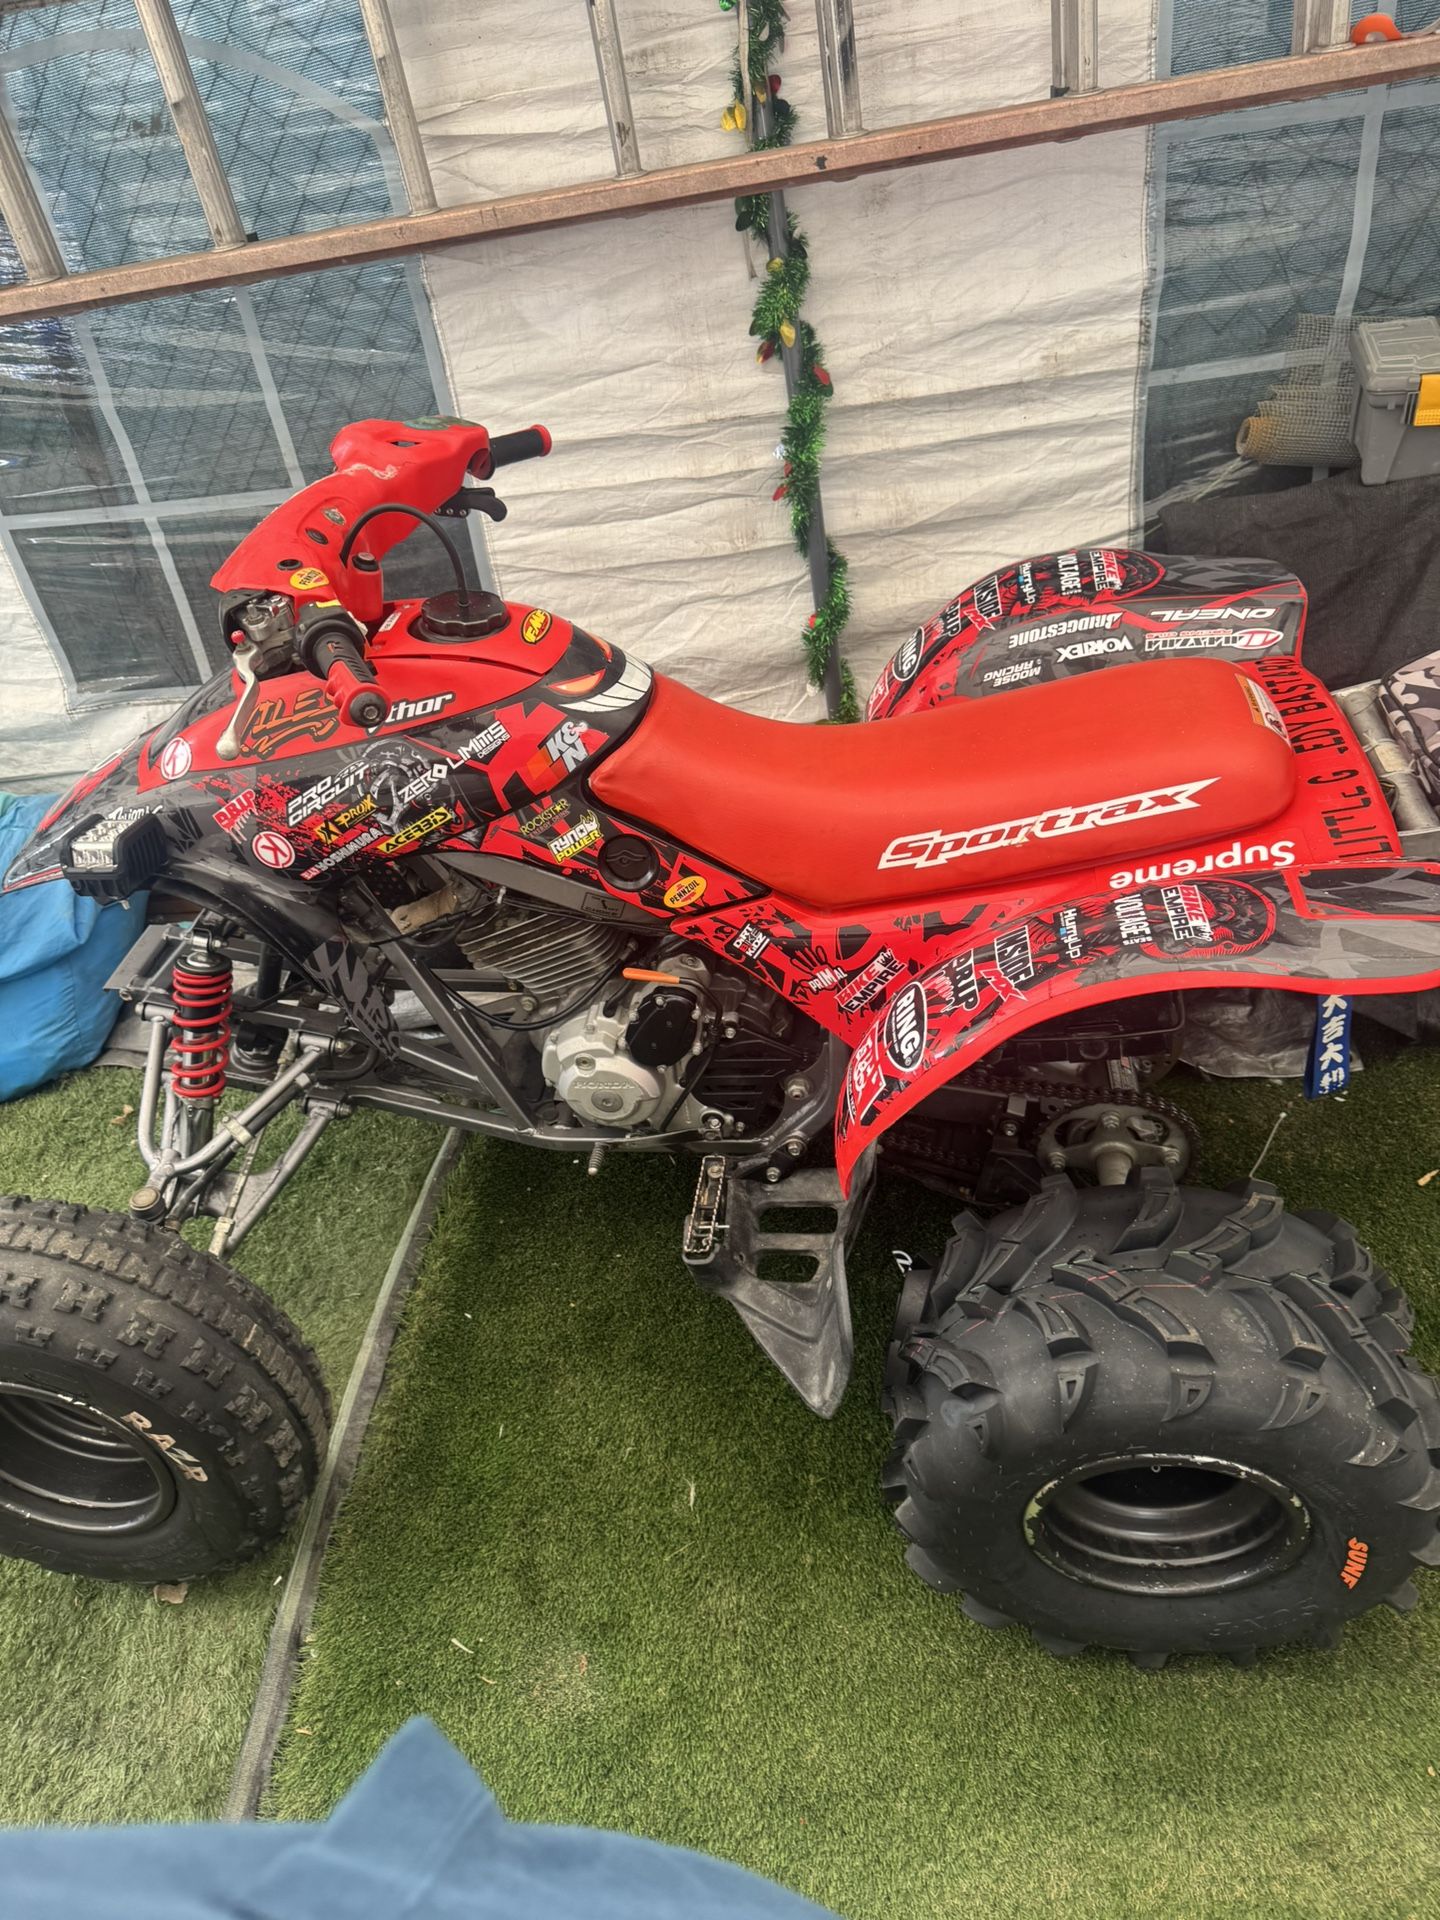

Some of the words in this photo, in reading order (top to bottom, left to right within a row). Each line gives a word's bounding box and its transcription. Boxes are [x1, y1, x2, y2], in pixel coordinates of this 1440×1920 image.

[1057, 553, 1080, 594] VOLTAGE
[524, 610, 549, 643] FMF
[1009, 612, 1123, 648] BRIDGESTONE
[1056, 635, 1134, 663] VORTEX
[983, 660, 1034, 682] RACING
[993, 666, 1041, 687] MOOSE
[477, 732, 511, 759] DESIGNS
[287, 772, 332, 813] PRO
[289, 764, 370, 827] CIRCUIT
[317, 826, 384, 872] YOSHIMURA
[555, 831, 601, 863] POWER
[1109, 840, 1296, 889] Supreme
[669, 879, 700, 905] PENNZOIL
[1181, 886, 1207, 923] BIKE
[1115, 894, 1150, 939] VOLTAGE
[1162, 887, 1194, 940] EMPIRE
[808, 967, 848, 995] PRIMAL
[837, 962, 881, 1004] BIKE
[847, 961, 905, 1013] EMPIRE
[898, 987, 921, 1063] RING
[574, 1080, 636, 1090] HONDA
[1340, 1537, 1369, 1589] SUNF
